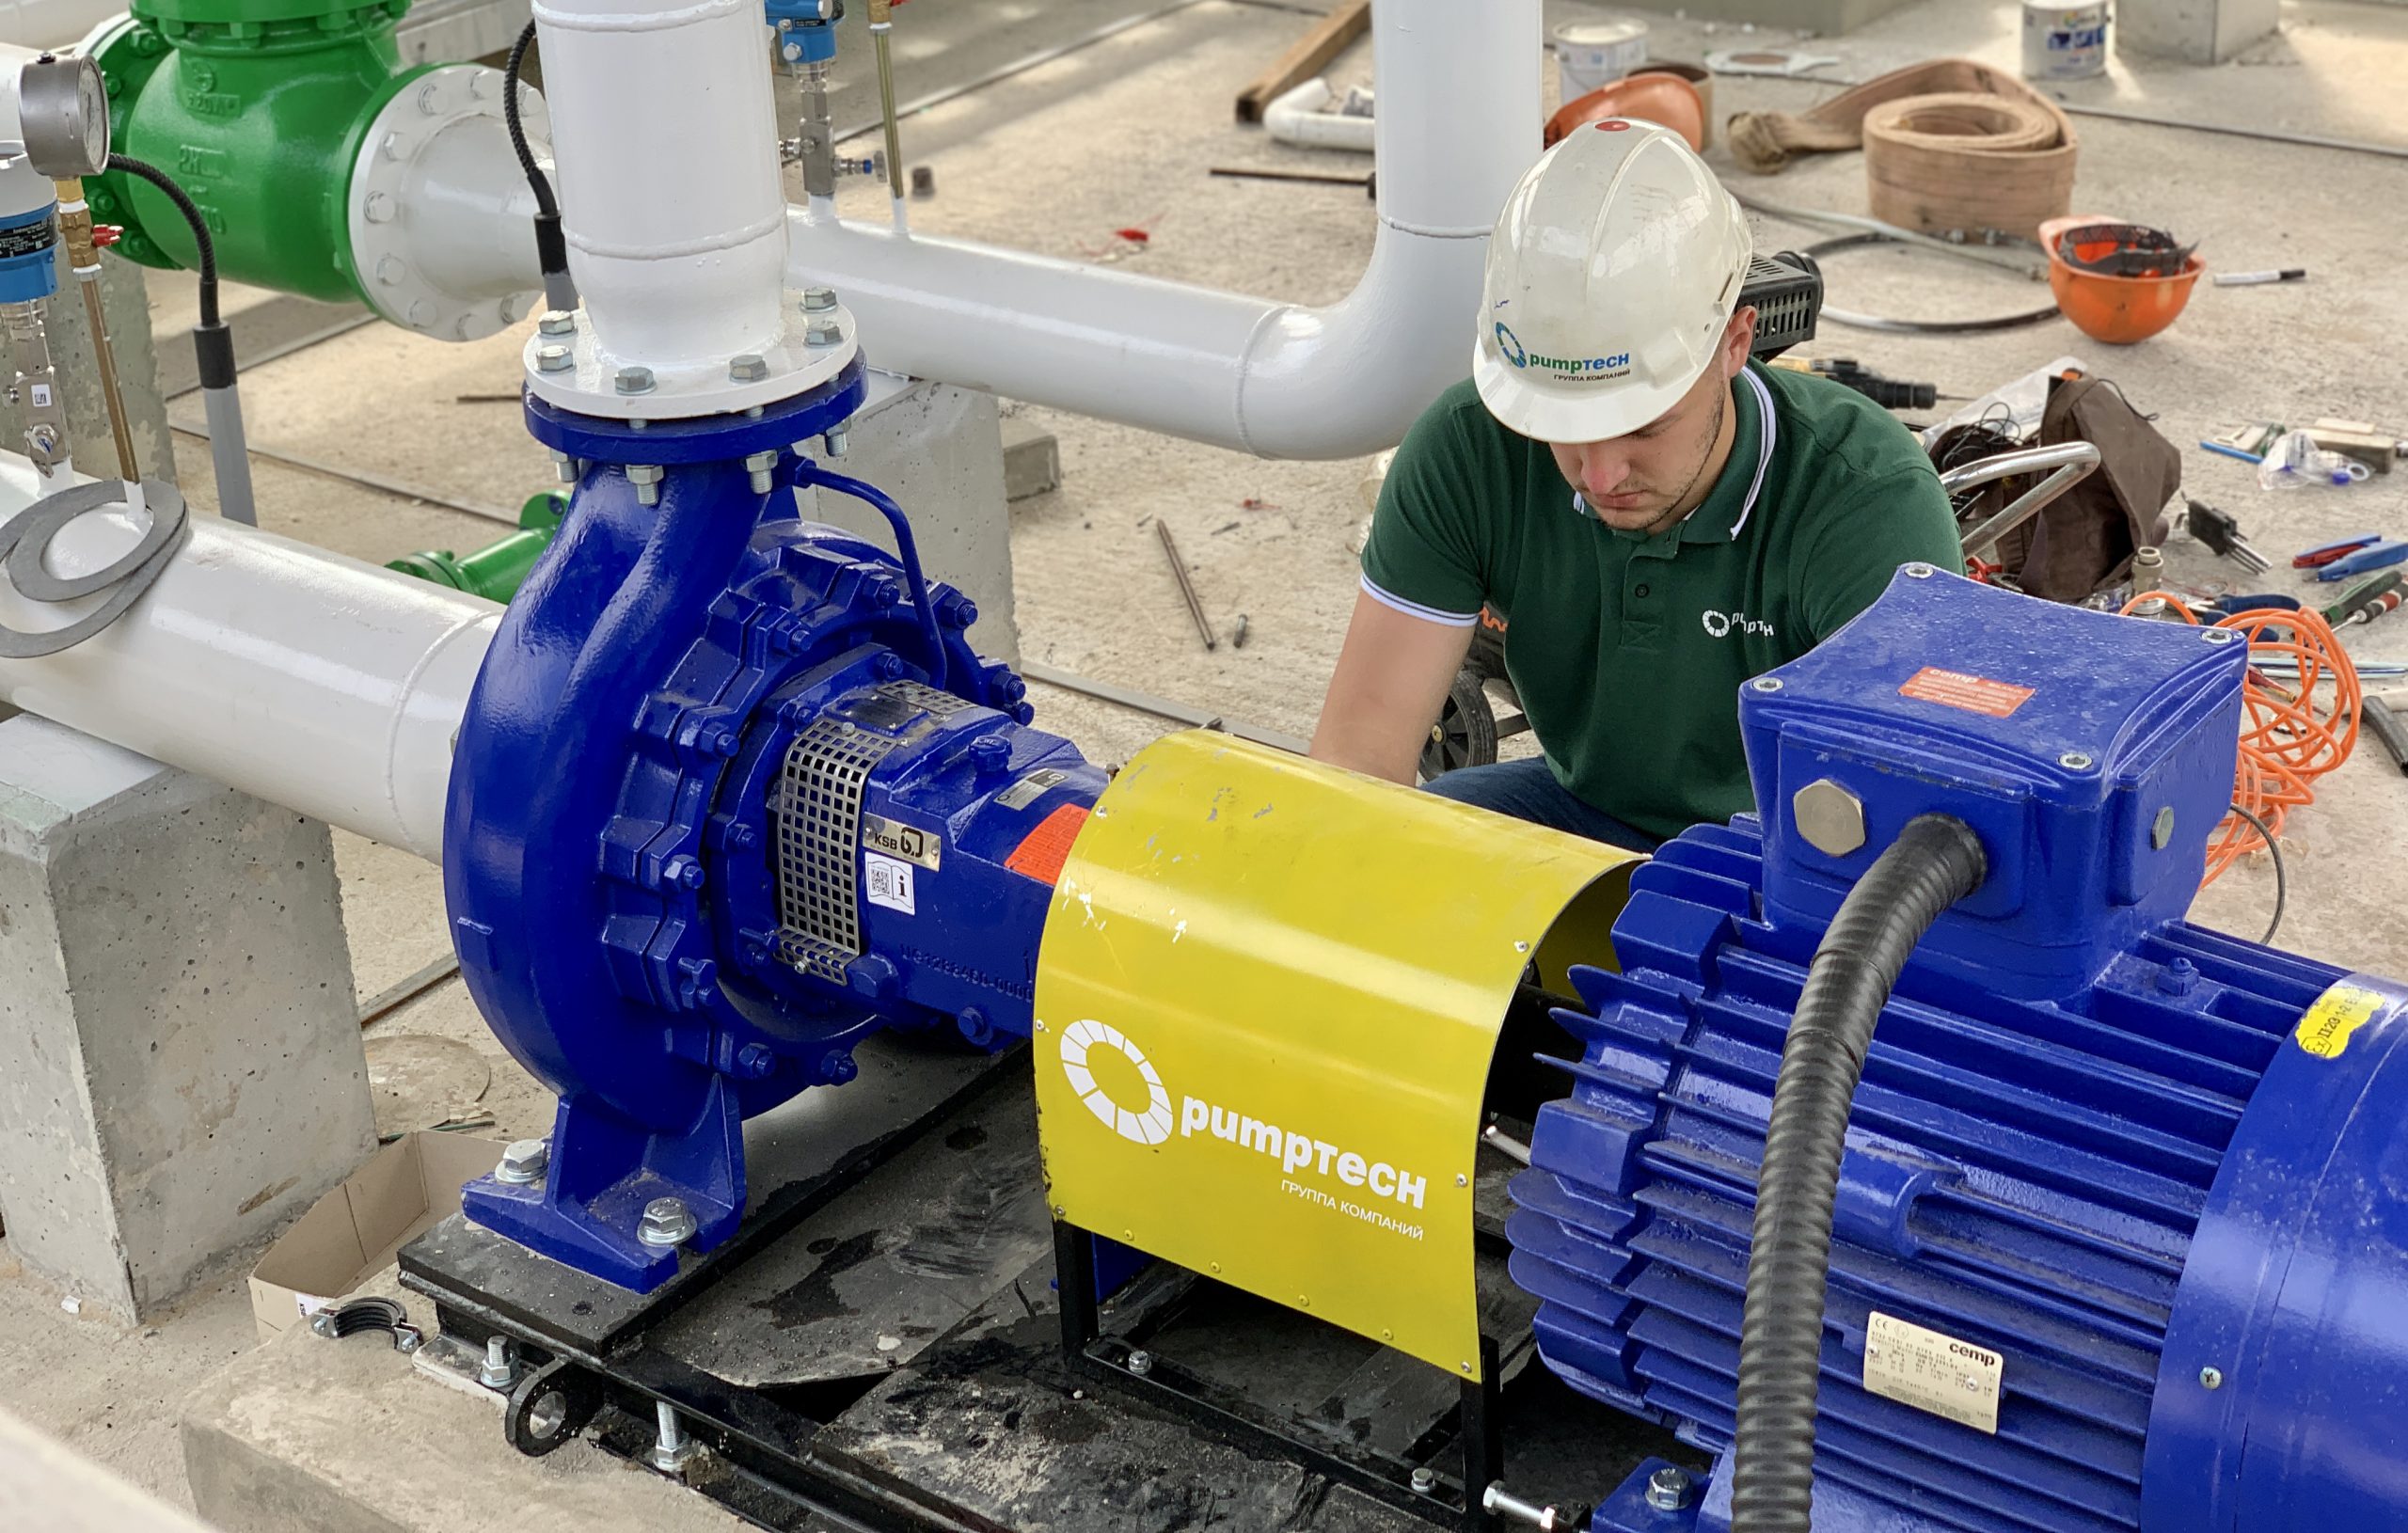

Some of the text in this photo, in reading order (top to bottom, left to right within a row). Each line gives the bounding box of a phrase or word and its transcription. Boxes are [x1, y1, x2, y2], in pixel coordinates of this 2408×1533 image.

[1553, 369, 1630, 382] ГРУППА КОМПАНИЙ
[874, 832, 897, 850] KSB
[1280, 1178, 1424, 1241] ГРУППА КОМПАНИЙ
[1949, 1342, 1995, 1367] cemp
